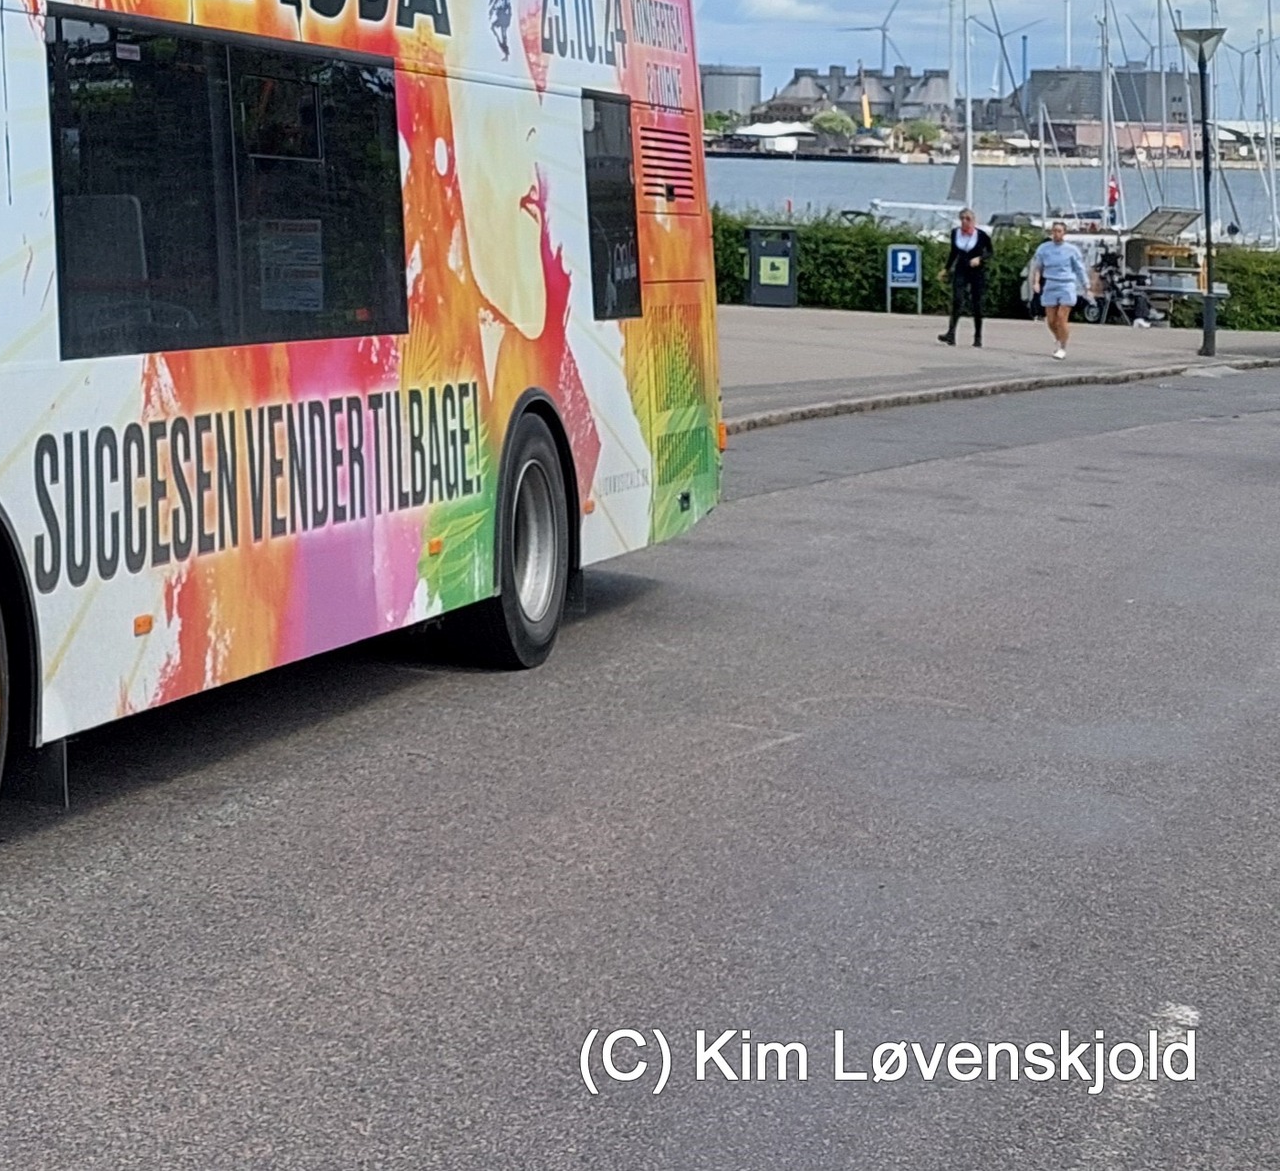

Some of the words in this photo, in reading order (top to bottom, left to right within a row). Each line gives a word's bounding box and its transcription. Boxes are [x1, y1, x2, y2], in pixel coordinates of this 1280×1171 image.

[897, 251, 912, 272] P
[34, 409, 238, 594] SUCCESEN
[244, 395, 366, 543] VENDER
[368, 381, 482, 516] TILBAGE!
